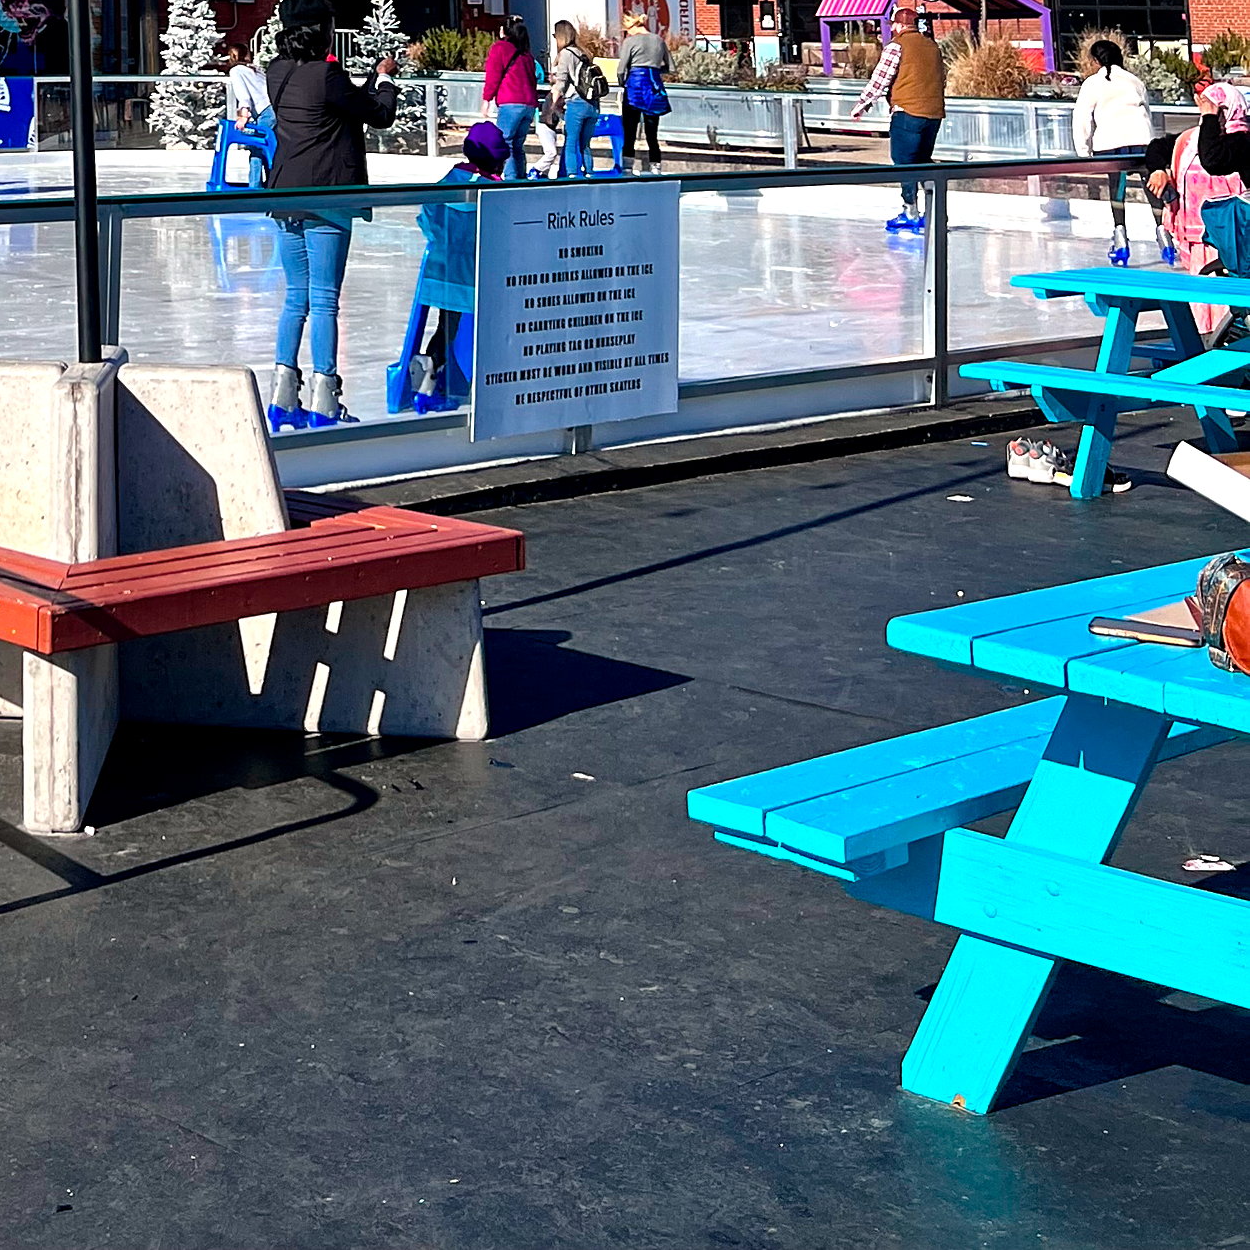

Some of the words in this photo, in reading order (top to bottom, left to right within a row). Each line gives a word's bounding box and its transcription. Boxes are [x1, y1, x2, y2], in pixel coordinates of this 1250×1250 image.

[547, 210, 575, 229] Rink
[579, 210, 614, 226] Rules
[559, 248, 569, 259] NO
[570, 245, 603, 258] SMOKING
[506, 276, 516, 287] NO
[518, 274, 537, 285] FOOD
[552, 270, 579, 284] DRINKS
[581, 267, 612, 280] ALLOWED
[615, 267, 625, 277] ON
[627, 265, 640, 276] THE
[641, 264, 653, 275] ICE
[525, 298, 534, 308] NO
[537, 295, 560, 307] SHOES
[563, 292, 595, 305] ALLOWED
[597, 291, 607, 301] ON
[609, 290, 622, 300] THE
[624, 288, 635, 299] ICE
[516, 322, 526, 333] NO
[528, 319, 566, 332] CARRYING
[568, 315, 603, 328] CHILDREN
[605, 314, 615, 324] ON
[616, 312, 629, 323] THE
[631, 311, 643, 321] ICE
[523, 346, 533, 356] NO
[536, 342, 566, 355] PLAYING
[569, 340, 582, 351] TAG
[486, 372, 517, 385] STICKER
[520, 368, 540, 381] MUST
[543, 367, 552, 378] BE
[554, 364, 576, 377] WORN
[578, 362, 592, 374] AND
[595, 359, 622, 371] VISIBLE
[624, 358, 632, 368] AT
[634, 356, 645, 367] ALL
[648, 353, 669, 365] TIMES
[515, 394, 525, 405] BE
[528, 388, 572, 404] RESPECTFUL
[574, 387, 583, 397] OF
[585, 384, 607, 396] OTHER
[610, 379, 641, 392] SKATERS
